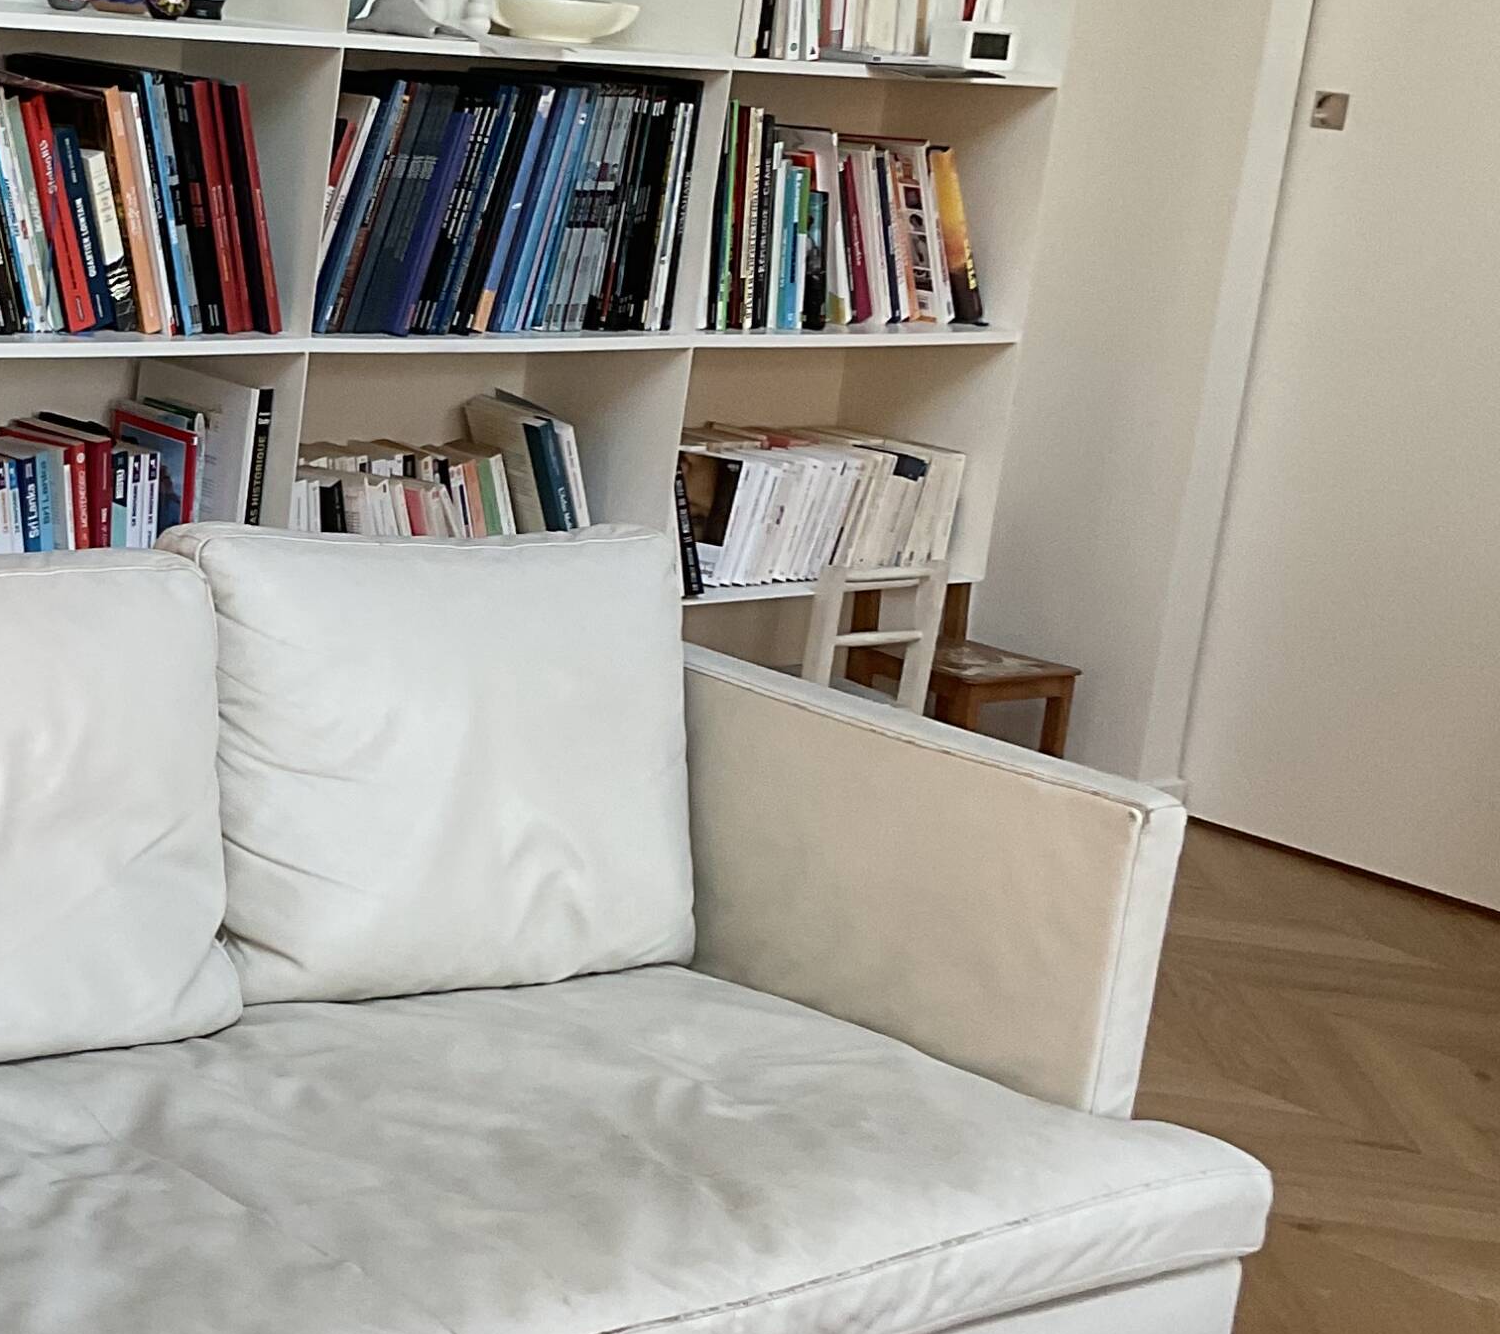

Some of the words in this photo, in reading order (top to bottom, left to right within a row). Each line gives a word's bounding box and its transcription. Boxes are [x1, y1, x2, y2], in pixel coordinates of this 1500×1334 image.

[75, 197, 90, 237] LOINTAIN
[82, 237, 97, 278] QUARTIER
[39, 460, 50, 502] Lanka
[250, 434, 268, 507] HISTORIQUE
[26, 483, 39, 520] Lanka
[28, 520, 40, 538] Sri
